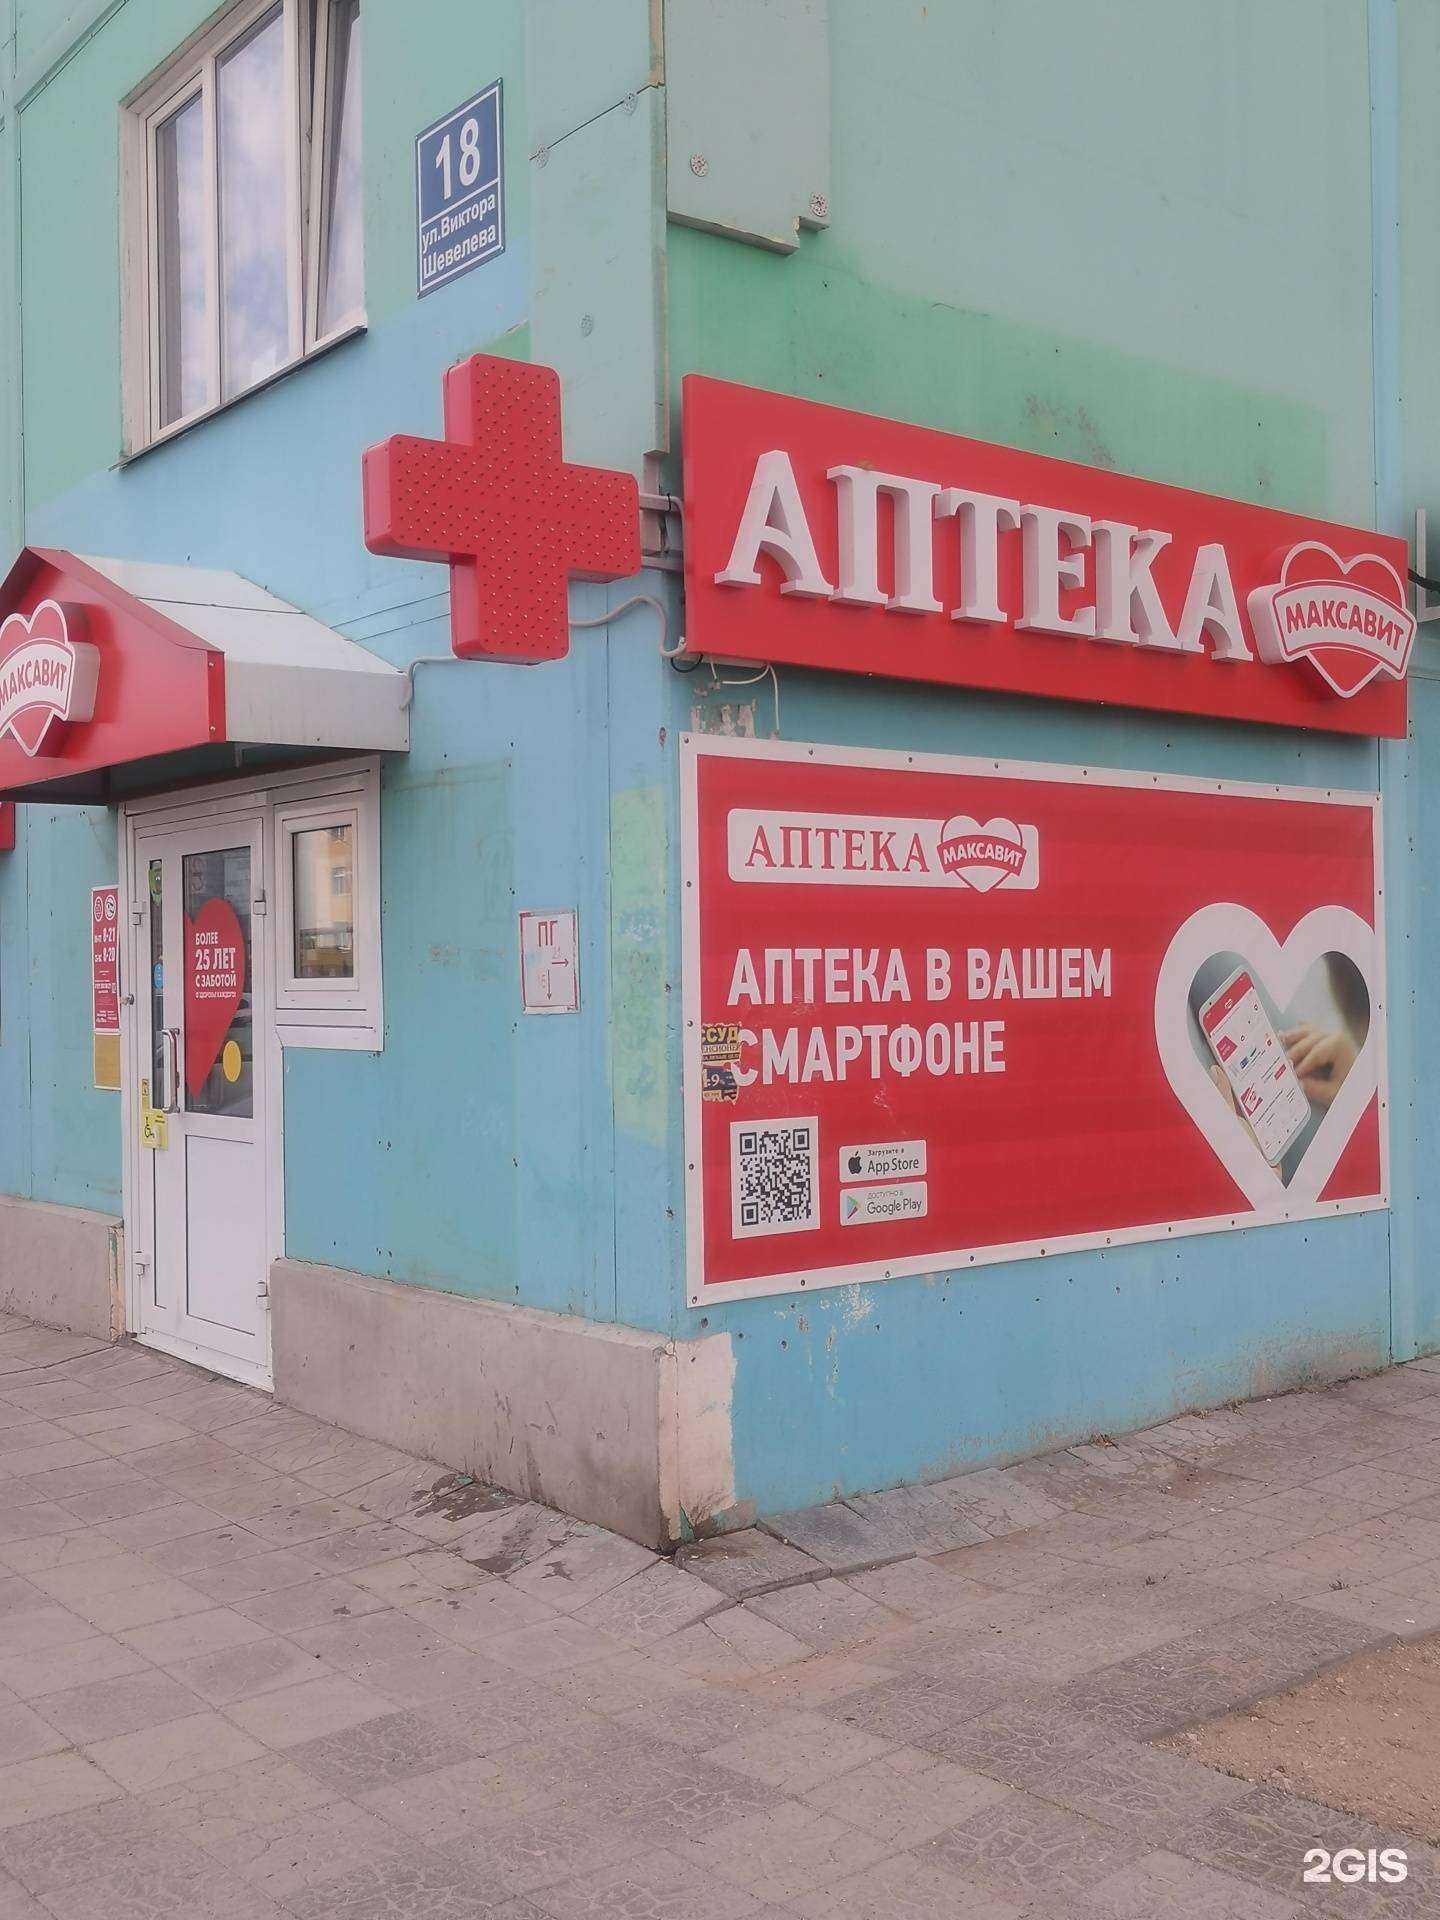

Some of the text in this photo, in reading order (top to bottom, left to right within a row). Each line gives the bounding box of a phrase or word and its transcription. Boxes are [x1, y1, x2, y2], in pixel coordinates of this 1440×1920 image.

[435, 118, 481, 200] 18
[423, 224, 496, 279] Шевелева
[714, 449, 1254, 662] АПТЕКА
[1285, 600, 1404, 650] МАКСАВИТ
[745, 825, 930, 873] АПТЕКА
[943, 842, 1023, 867] МАКСАВИТ
[195, 931, 219, 946] БОЛЕЕ
[195, 947, 236, 971] 25 ЛЕТ
[195, 970, 237, 988] С ЗАБОТОЙ
[727, 948, 1111, 1006] АПТЕКА В ВАШЕМ
[731, 1021, 1006, 1087] СМАРТФОНЕ
[867, 1158, 920, 1175] App Store
[866, 1198, 922, 1215] Google Play
